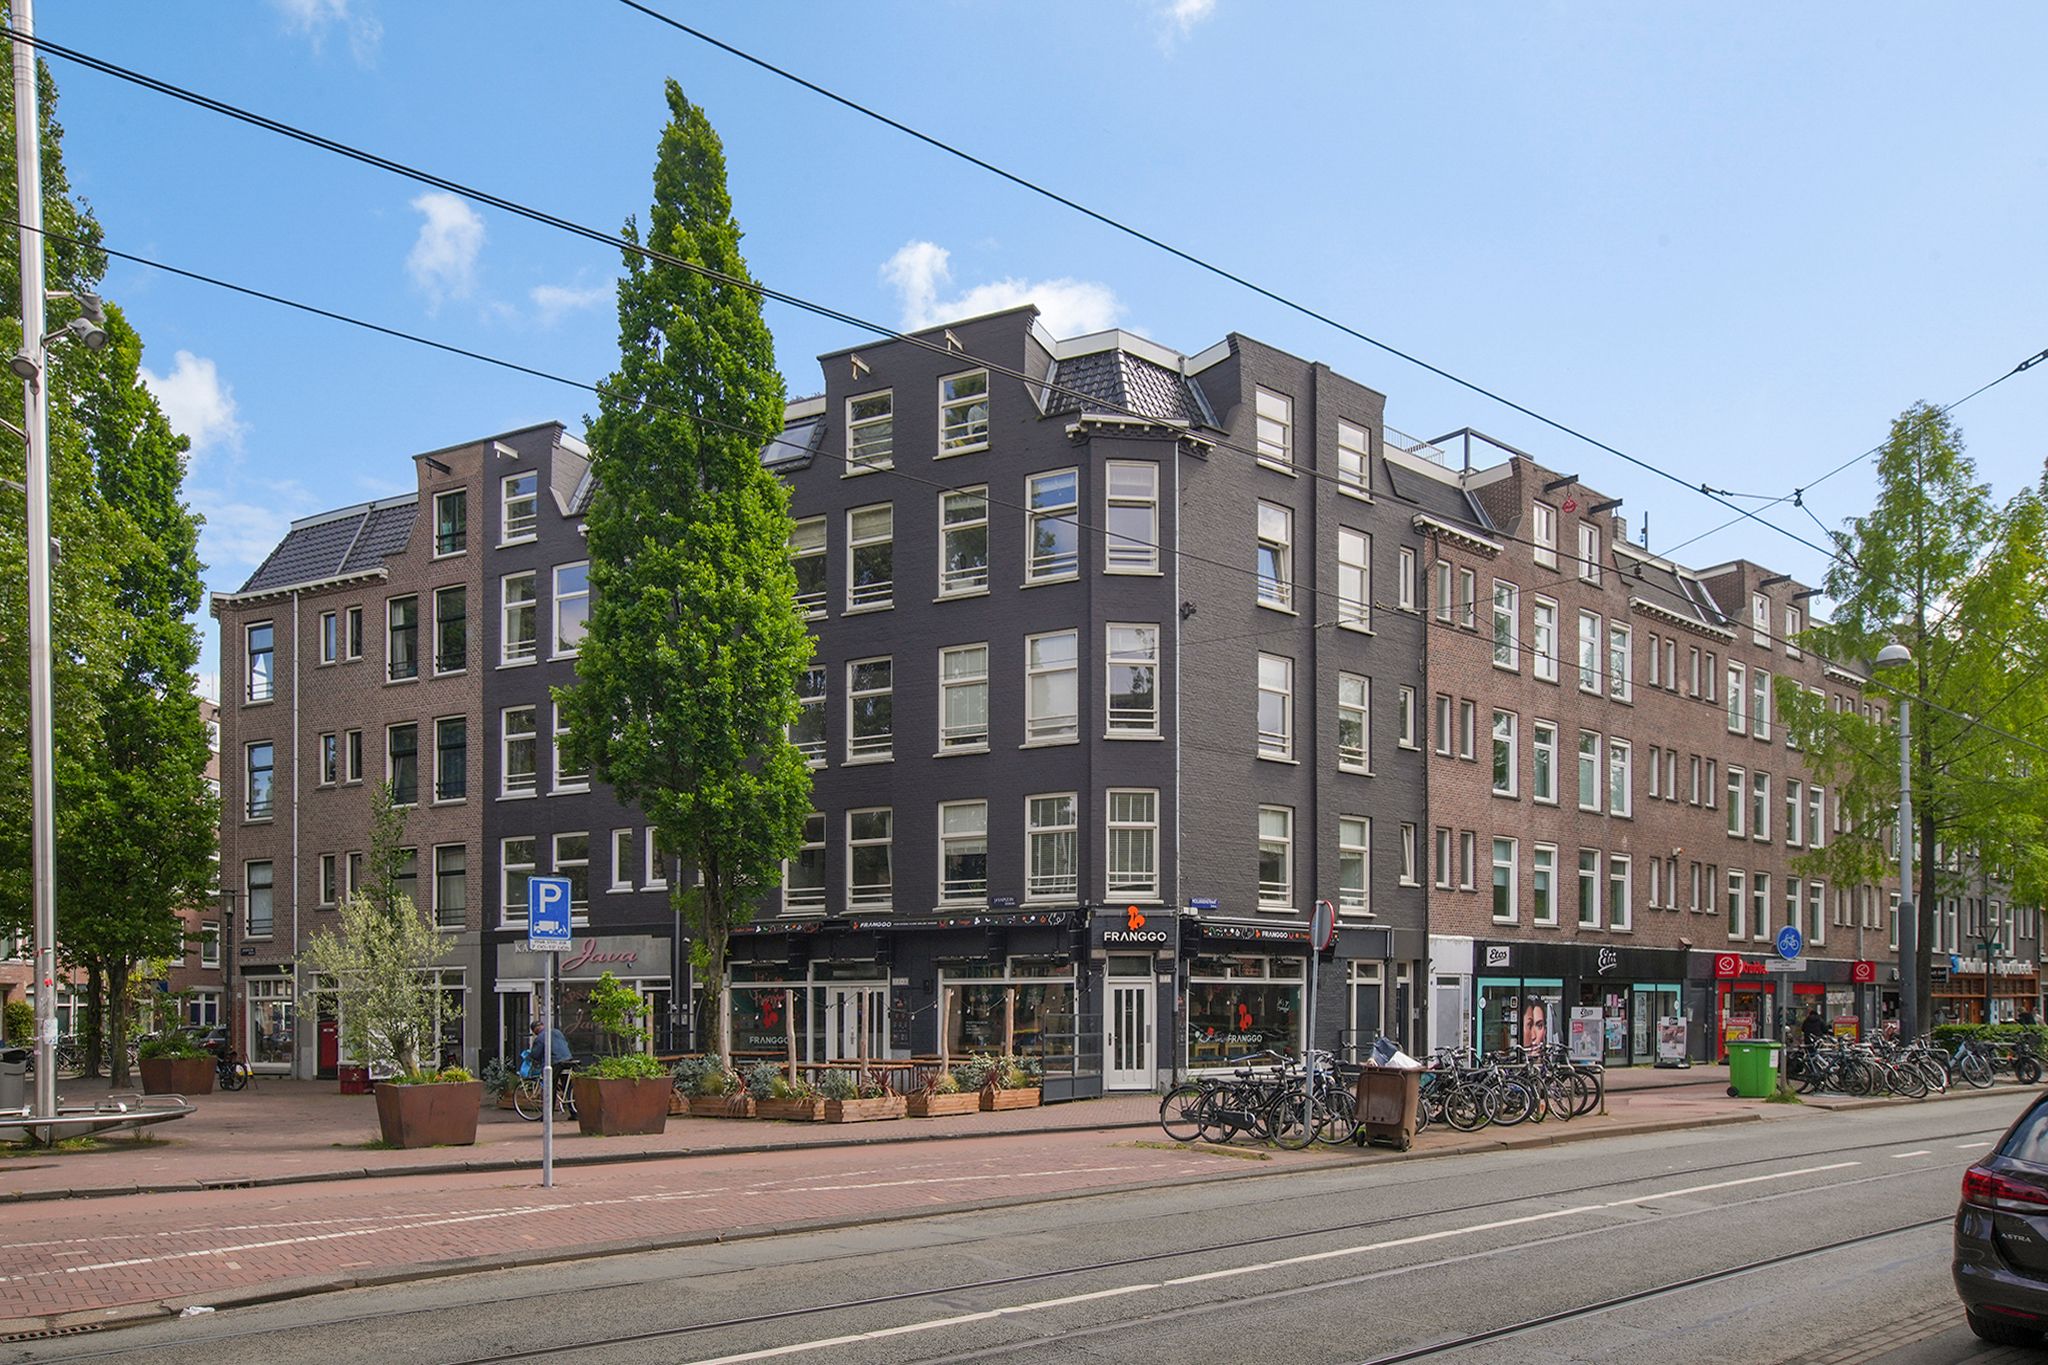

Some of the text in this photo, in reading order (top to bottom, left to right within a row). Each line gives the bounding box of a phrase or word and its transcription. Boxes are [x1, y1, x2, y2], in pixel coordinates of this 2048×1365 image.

[539, 884, 562, 913] P
[1104, 931, 1167, 942] FRANGGO
[1261, 930, 1289, 938] FRANGGO
[560, 938, 638, 972] Java
[1489, 948, 1507, 962] Etos
[1228, 1033, 1263, 1043] FRANGGO
[2000, 1232, 2032, 1243] ASTRA
